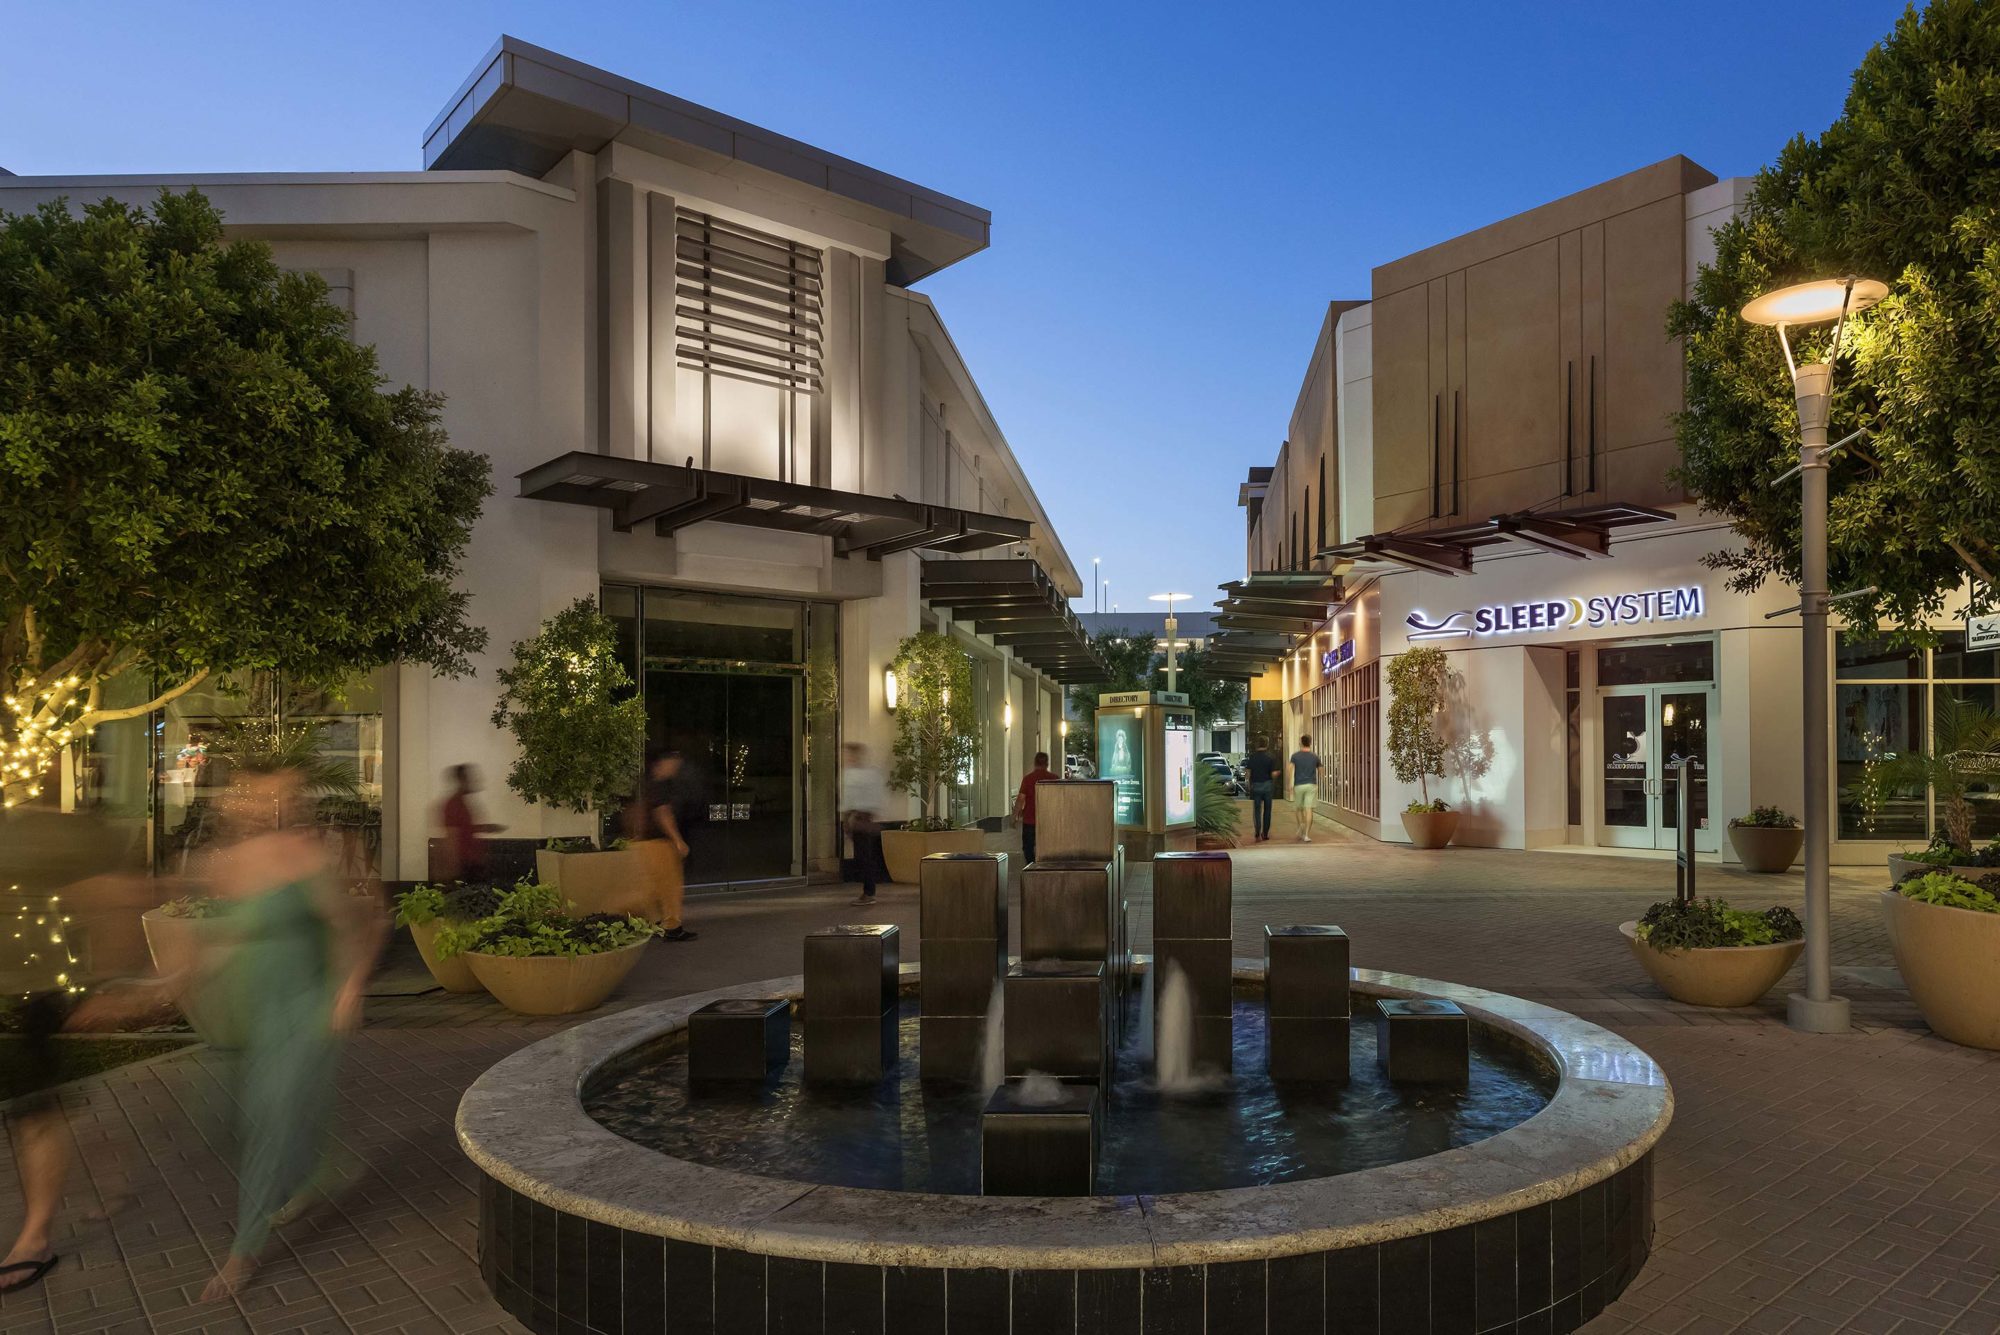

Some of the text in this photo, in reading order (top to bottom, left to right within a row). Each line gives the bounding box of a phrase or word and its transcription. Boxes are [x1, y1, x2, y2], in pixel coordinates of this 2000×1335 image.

[1475, 587, 1701, 633] SLEEP SYSTEM
[1109, 695, 1139, 704] DIRECTORY
